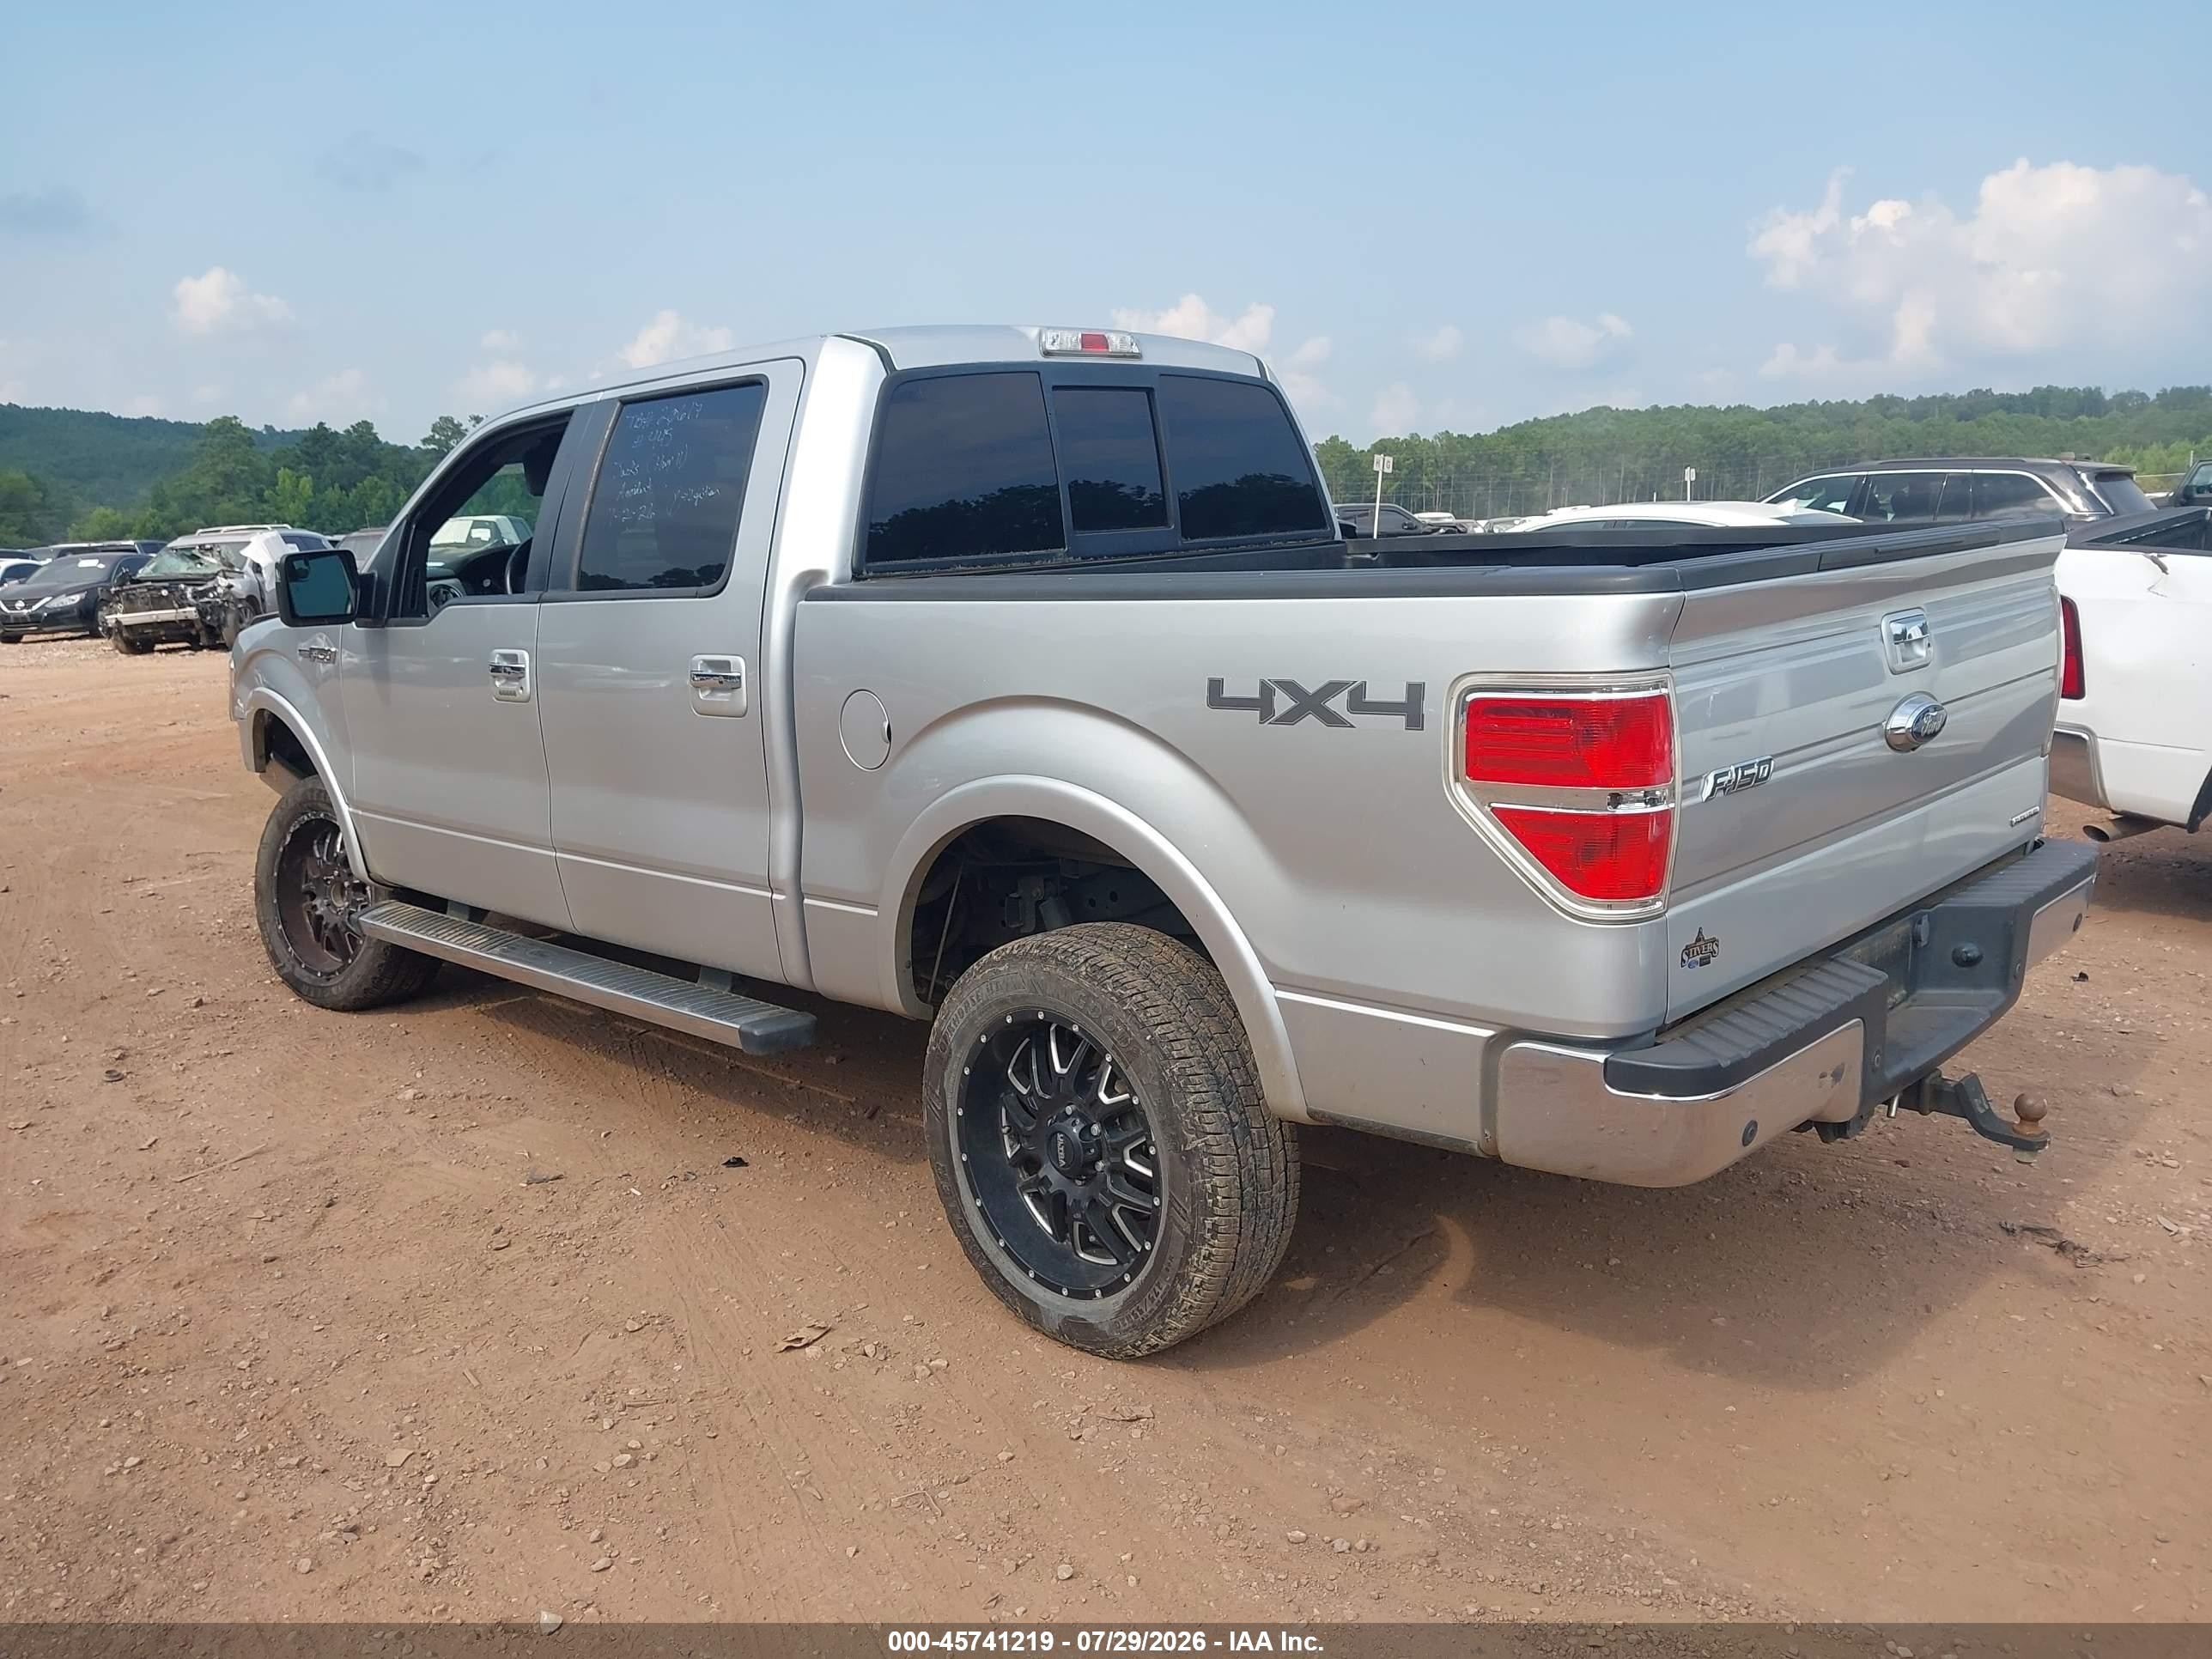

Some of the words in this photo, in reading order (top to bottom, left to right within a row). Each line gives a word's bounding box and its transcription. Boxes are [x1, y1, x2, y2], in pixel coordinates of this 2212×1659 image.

[1920, 710, 1944, 737] Ford
[933, 986, 983, 1060] ORKHORSE
[1056, 1133, 1066, 1168] ULTRA
